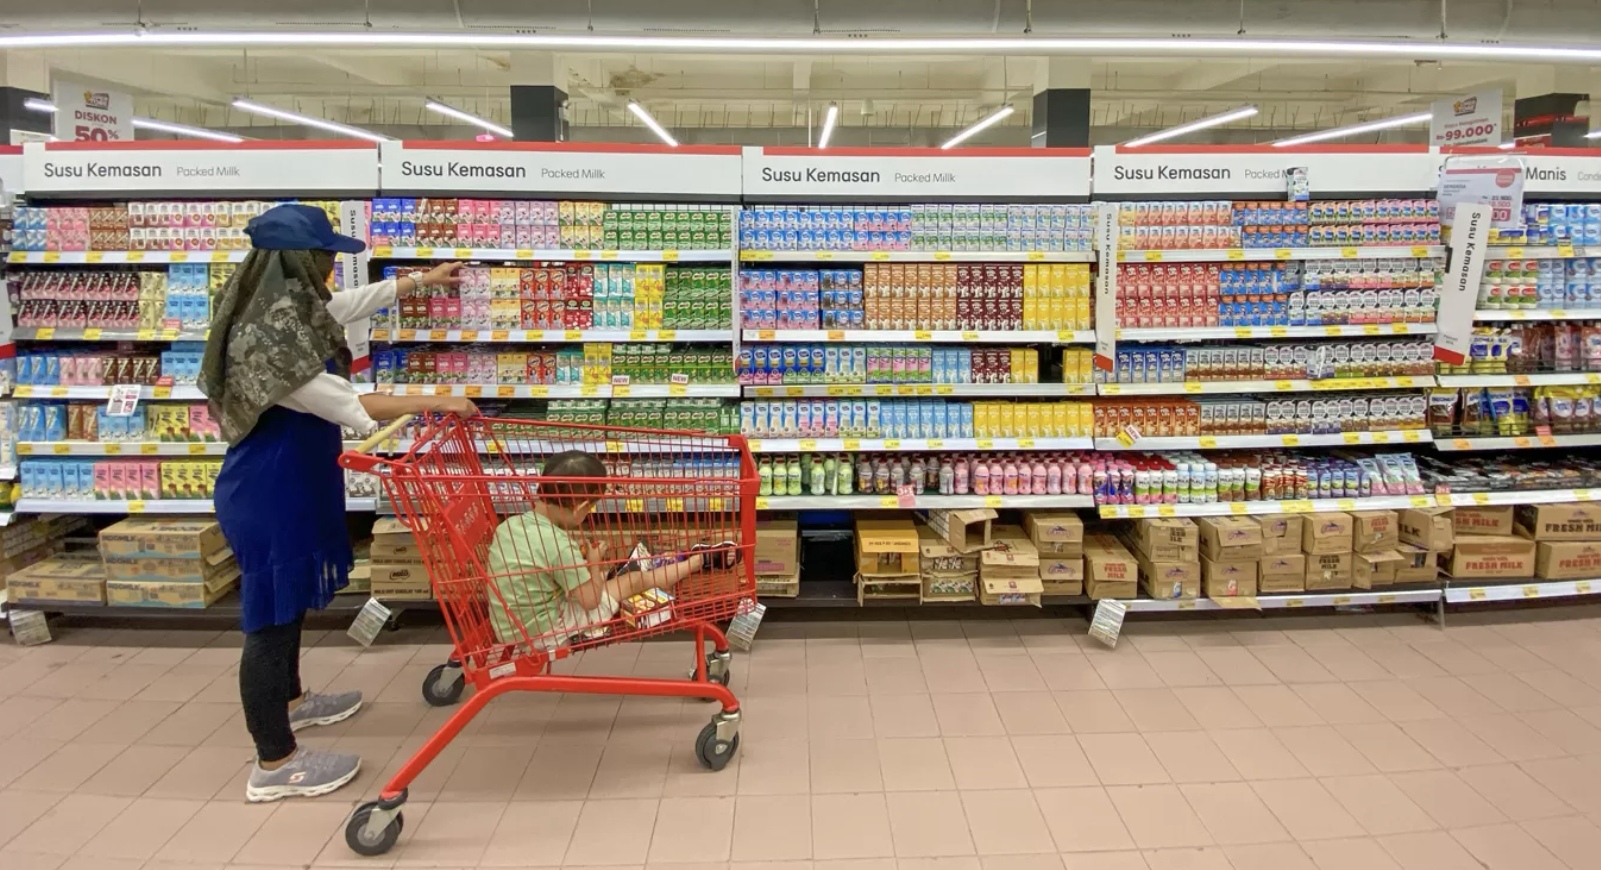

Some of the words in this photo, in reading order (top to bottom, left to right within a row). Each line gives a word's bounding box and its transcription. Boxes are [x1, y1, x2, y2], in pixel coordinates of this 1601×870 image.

[74, 110, 117, 124] DISKON
[74, 125, 120, 142] 50%
[45, 163, 82, 177] Susu
[88, 163, 161, 177] Kemasan
[177, 167, 214, 176] Packed
[402, 161, 443, 176] Susu
[448, 162, 525, 177] Kemasan
[542, 168, 579, 178] Packed
[762, 167, 801, 181] Susu
[807, 168, 880, 182] Kemasan
[1114, 166, 1153, 180] Susu
[1158, 166, 1230, 179] Kemasan
[1245, 169, 1280, 179] Packed
[1526, 166, 1566, 180] Manis
[895, 173, 930, 182] Packed
[1578, 172, 1601, 181] Cond
[1469, 212, 1481, 239] Susu
[1459, 243, 1476, 292] Kemasan
[1128, 427, 1138, 439] NEW
[1546, 523, 1583, 532] FRESH
[1500, 561, 1523, 569] MILK
[1559, 558, 1591, 568] FRESH
